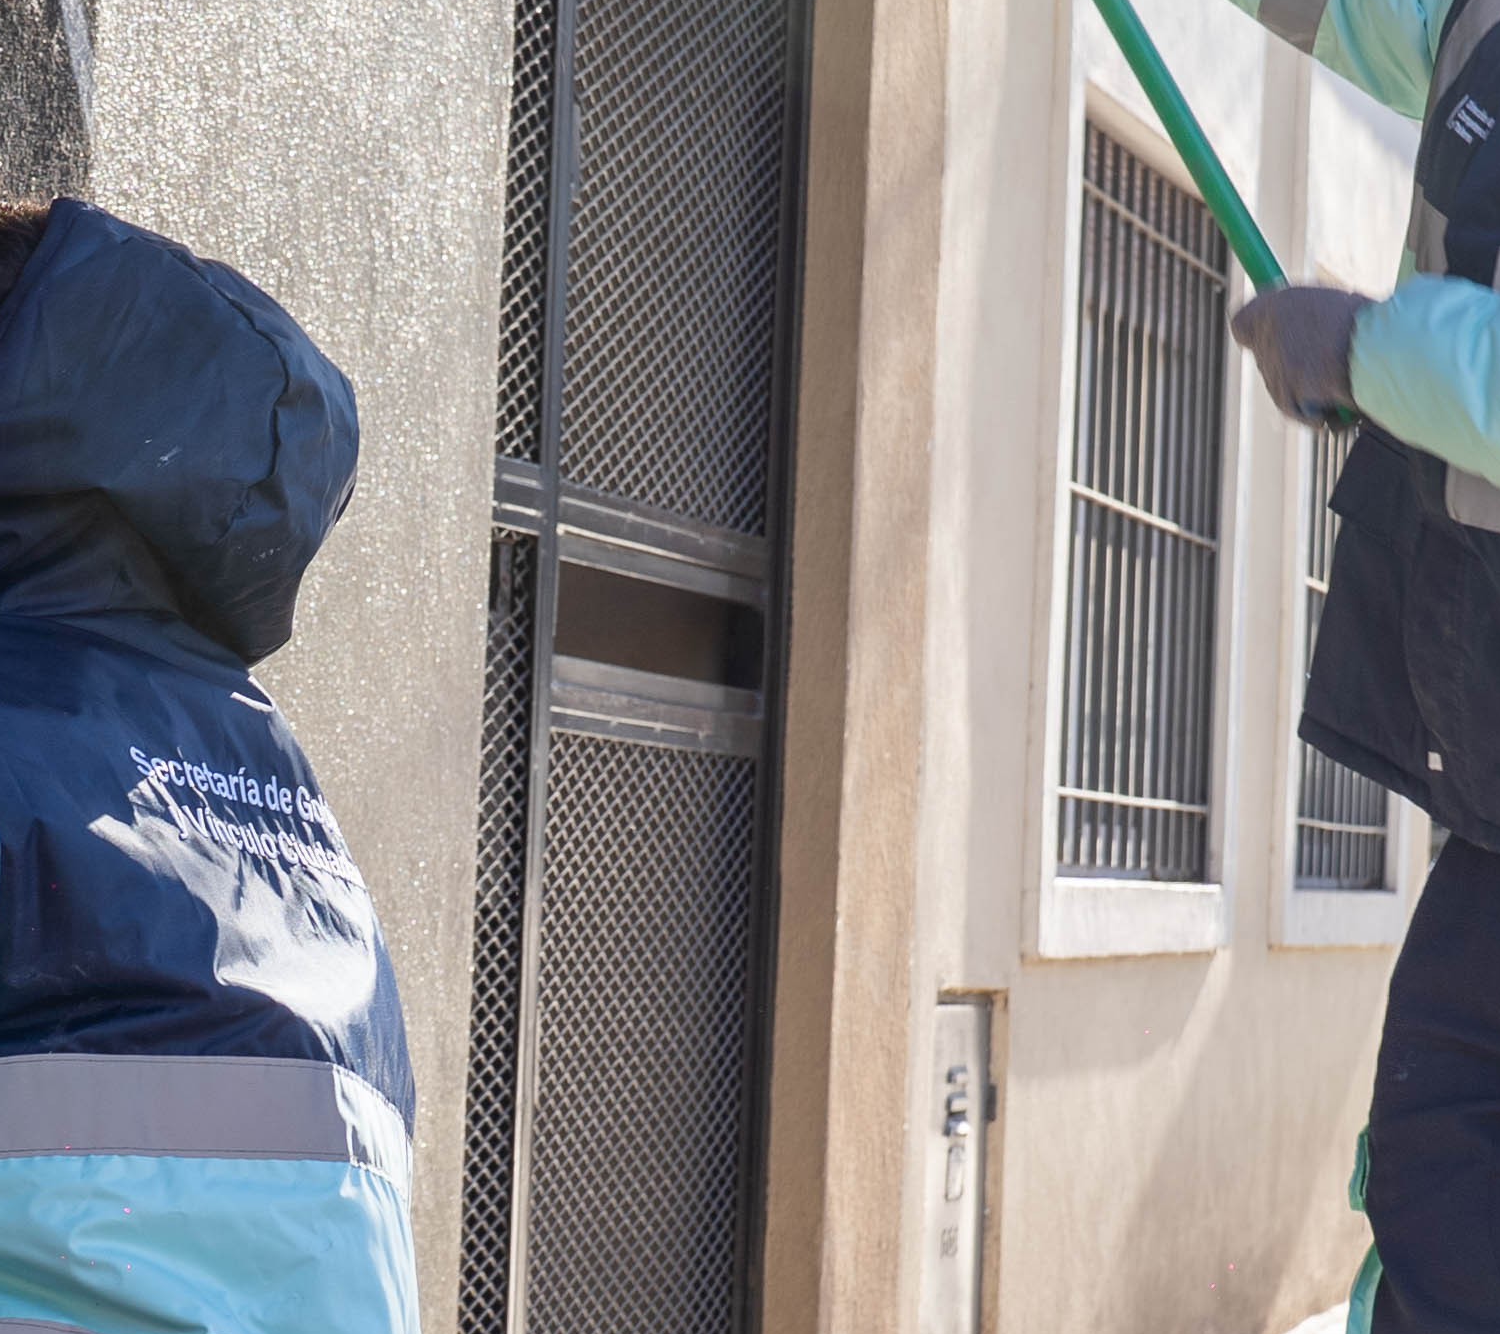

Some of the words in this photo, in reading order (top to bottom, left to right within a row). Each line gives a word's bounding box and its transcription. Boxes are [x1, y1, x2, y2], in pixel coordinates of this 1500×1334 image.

[129, 745, 264, 808] Secretaría
[265, 774, 293, 815] de
[182, 803, 280, 860] Vínculo
